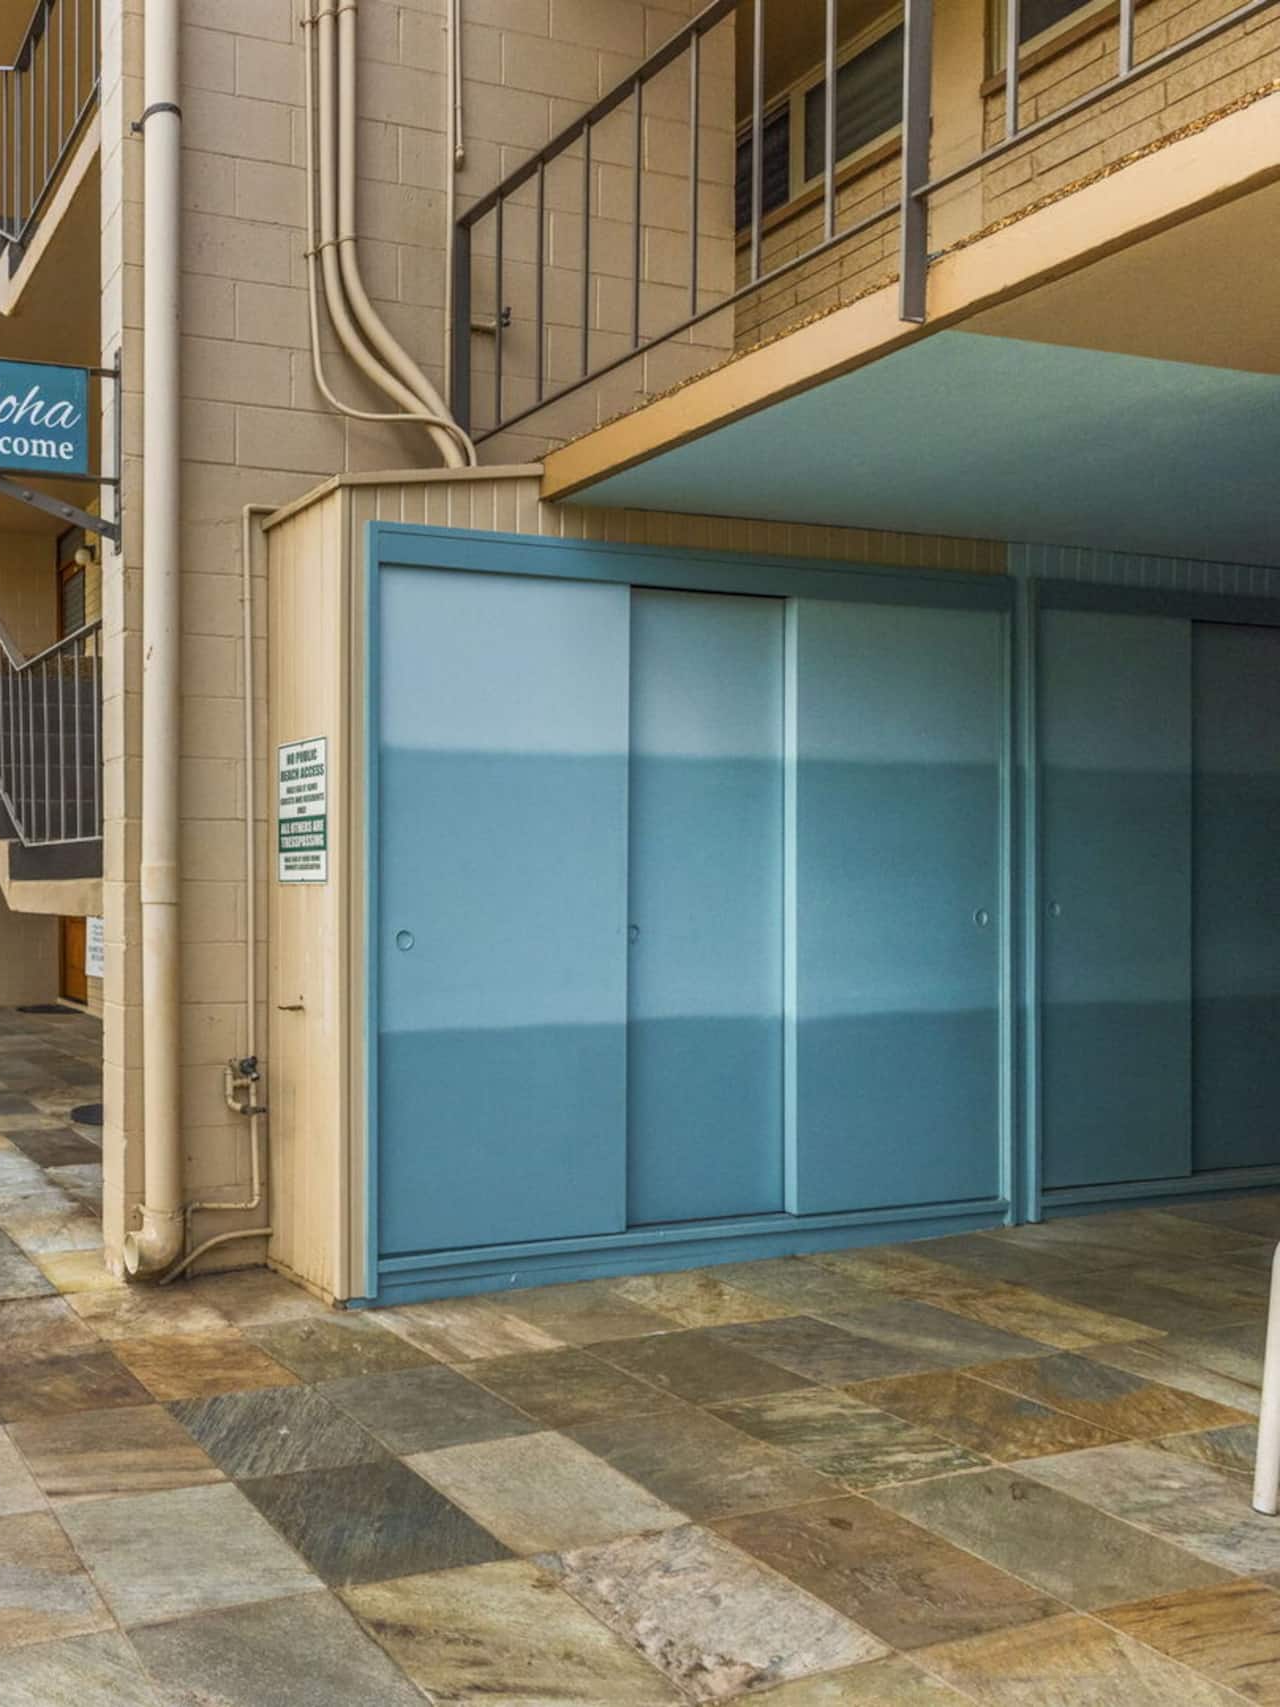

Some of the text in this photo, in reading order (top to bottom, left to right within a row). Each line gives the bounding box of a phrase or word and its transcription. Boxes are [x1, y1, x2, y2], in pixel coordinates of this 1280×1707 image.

[296, 748, 317, 763] PUBLIC
[281, 763, 324, 782] BEACH ACCESS
